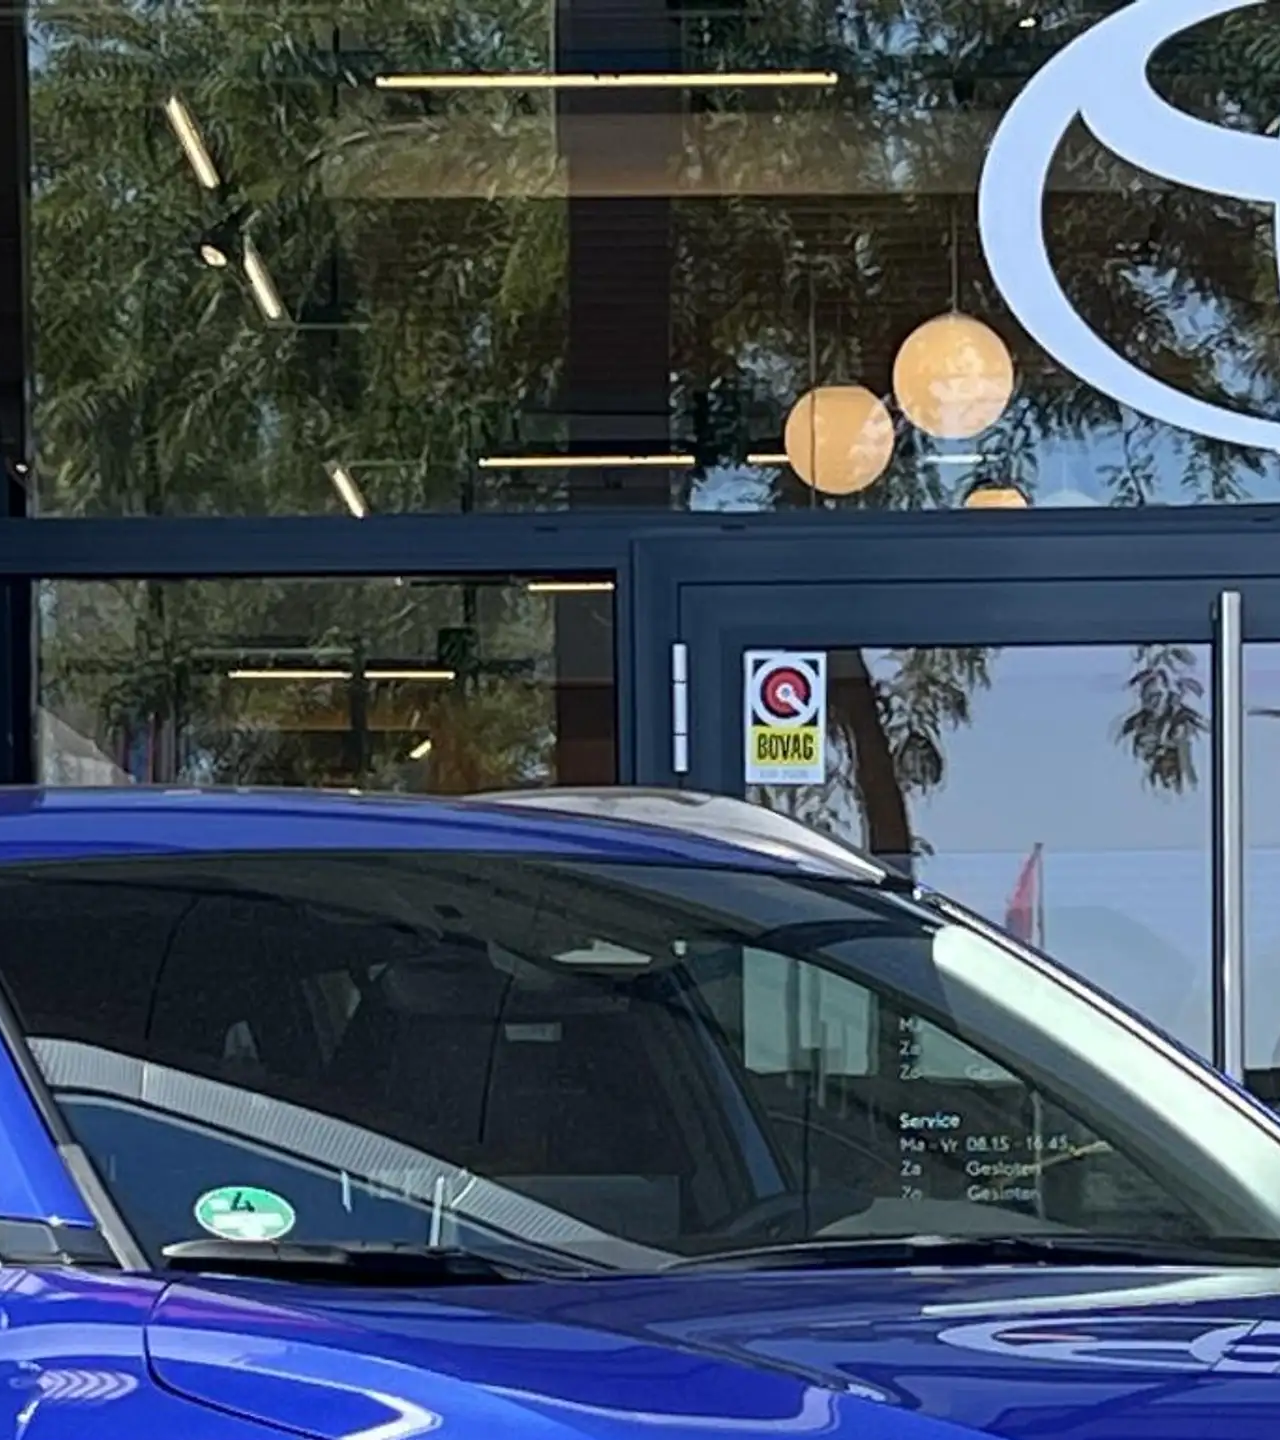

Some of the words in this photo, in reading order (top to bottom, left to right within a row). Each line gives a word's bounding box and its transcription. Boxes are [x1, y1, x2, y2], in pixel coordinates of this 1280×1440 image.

[757, 733, 814, 761] BOVAG
[899, 1112, 961, 1129] Service
[899, 1138, 925, 1151] Ma
[900, 1159, 922, 1177] Za
